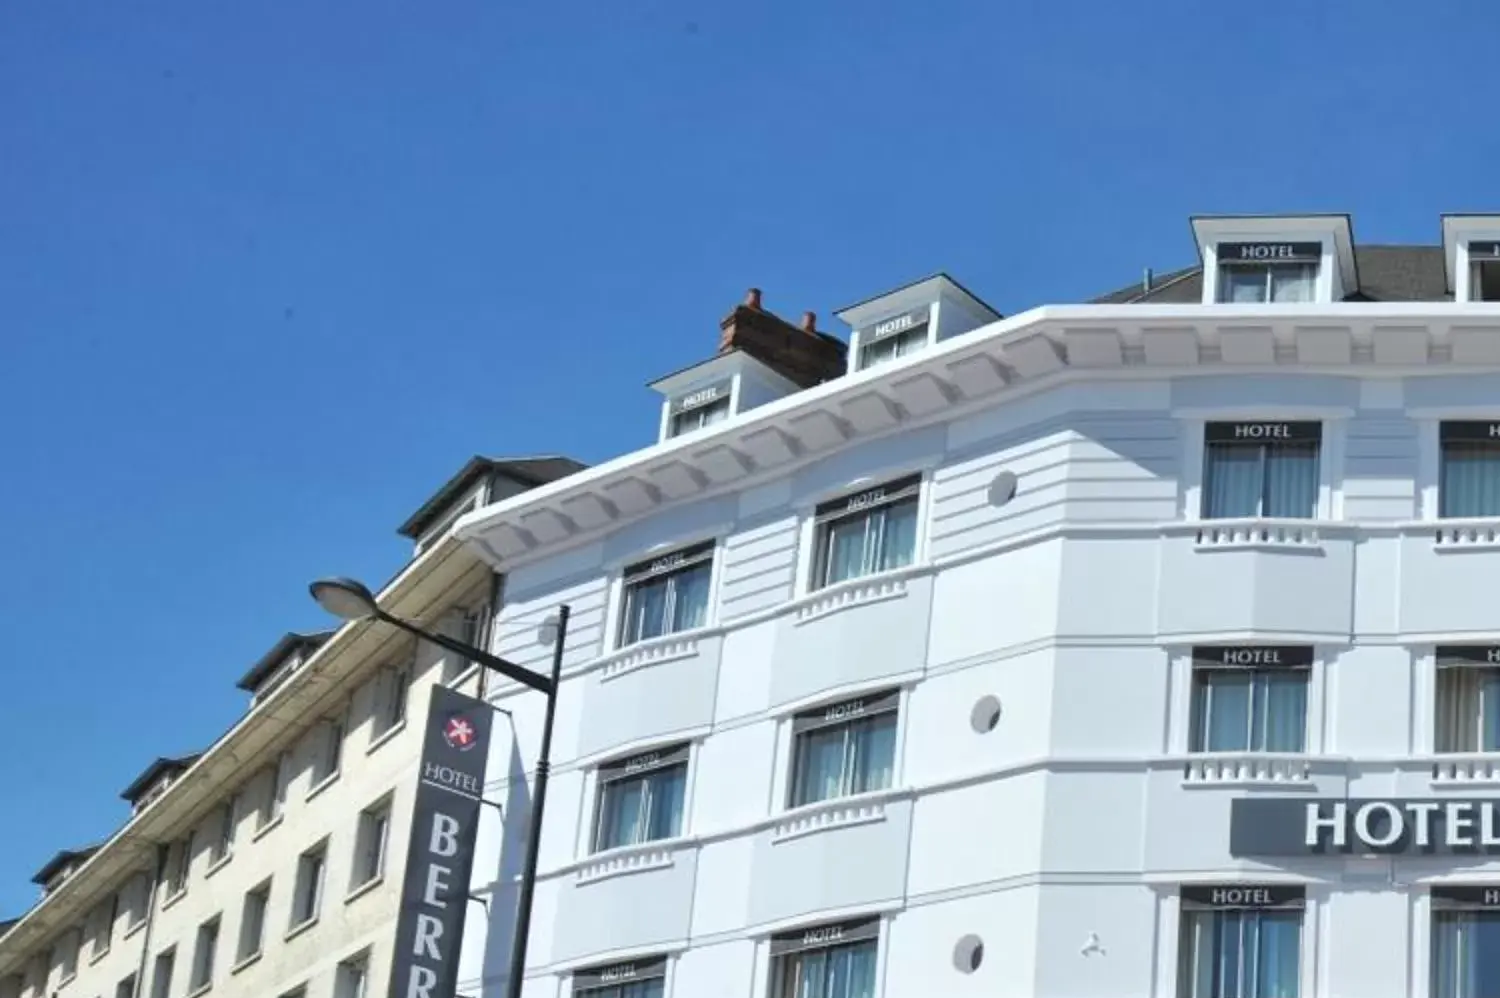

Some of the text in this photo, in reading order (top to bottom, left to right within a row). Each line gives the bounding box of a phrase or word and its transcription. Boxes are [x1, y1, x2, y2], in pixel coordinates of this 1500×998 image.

[1241, 245, 1295, 258] HOTEL
[1235, 424, 1291, 439] HOTEL
[1223, 649, 1282, 665] HOTEL
[423, 762, 480, 794] HOTEL
[1212, 889, 1273, 904] HOTEL
